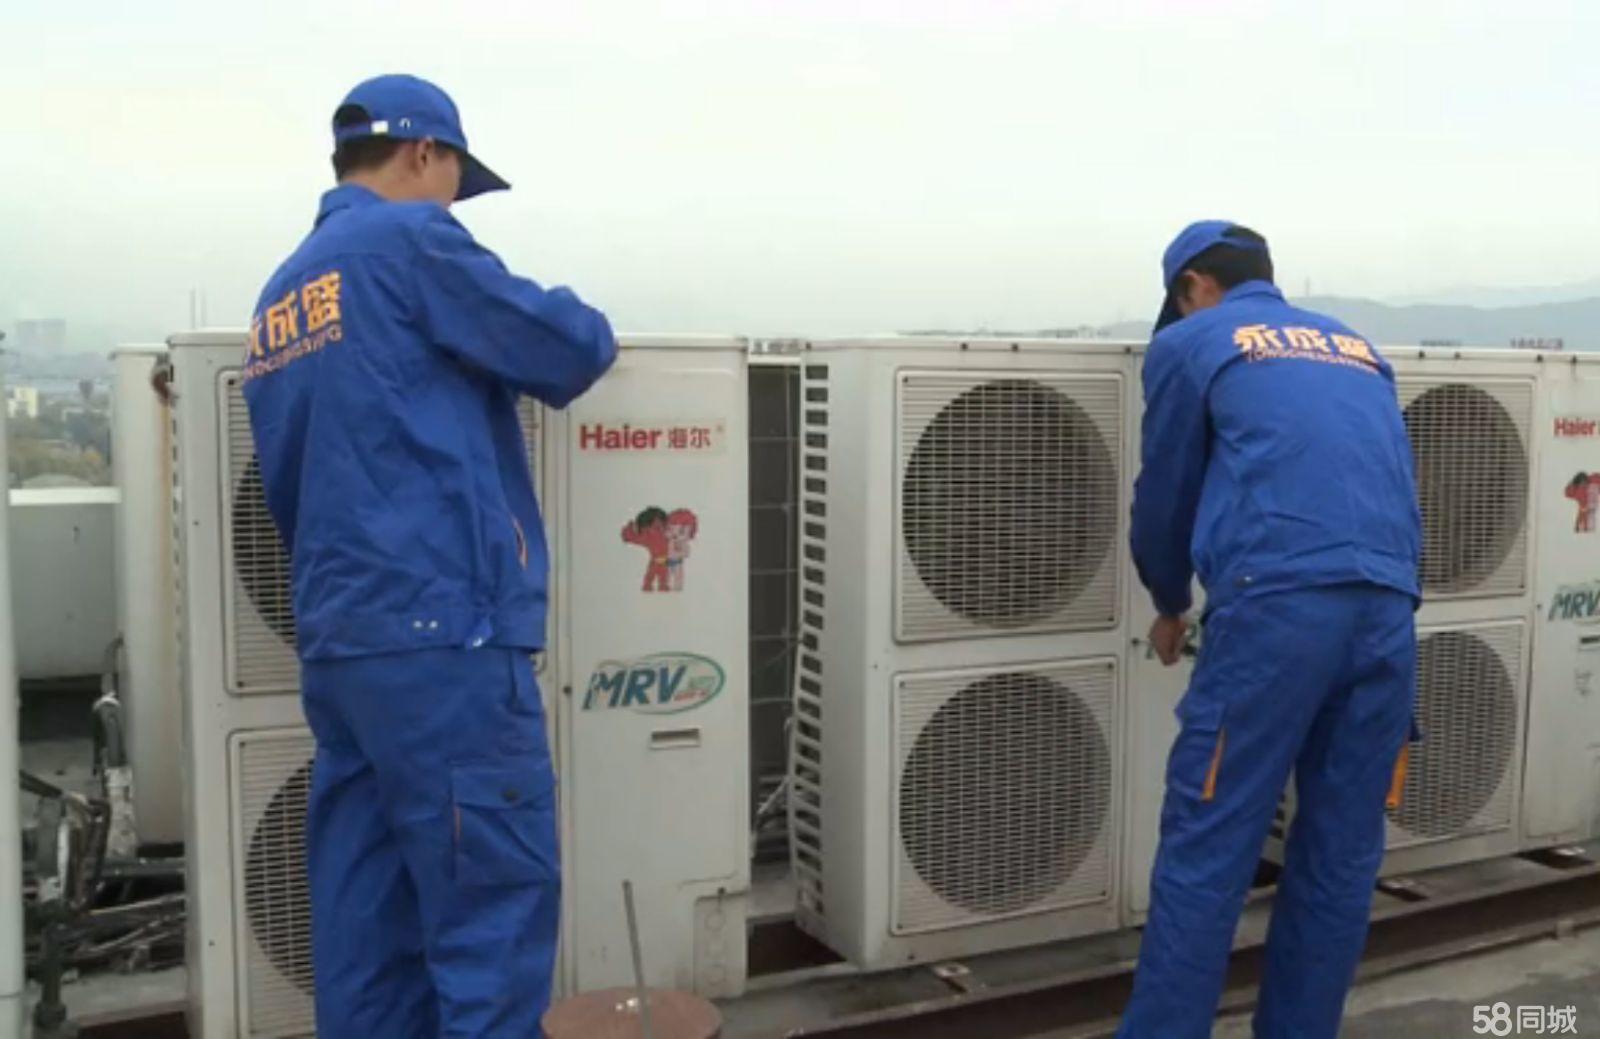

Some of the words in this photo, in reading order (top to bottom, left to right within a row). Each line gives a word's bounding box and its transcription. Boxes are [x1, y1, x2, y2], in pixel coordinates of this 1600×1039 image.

[580, 423, 662, 449] Haier
[668, 426, 711, 449] 海尔
[1553, 417, 1596, 436] Haier
[582, 664, 687, 710] MRV
